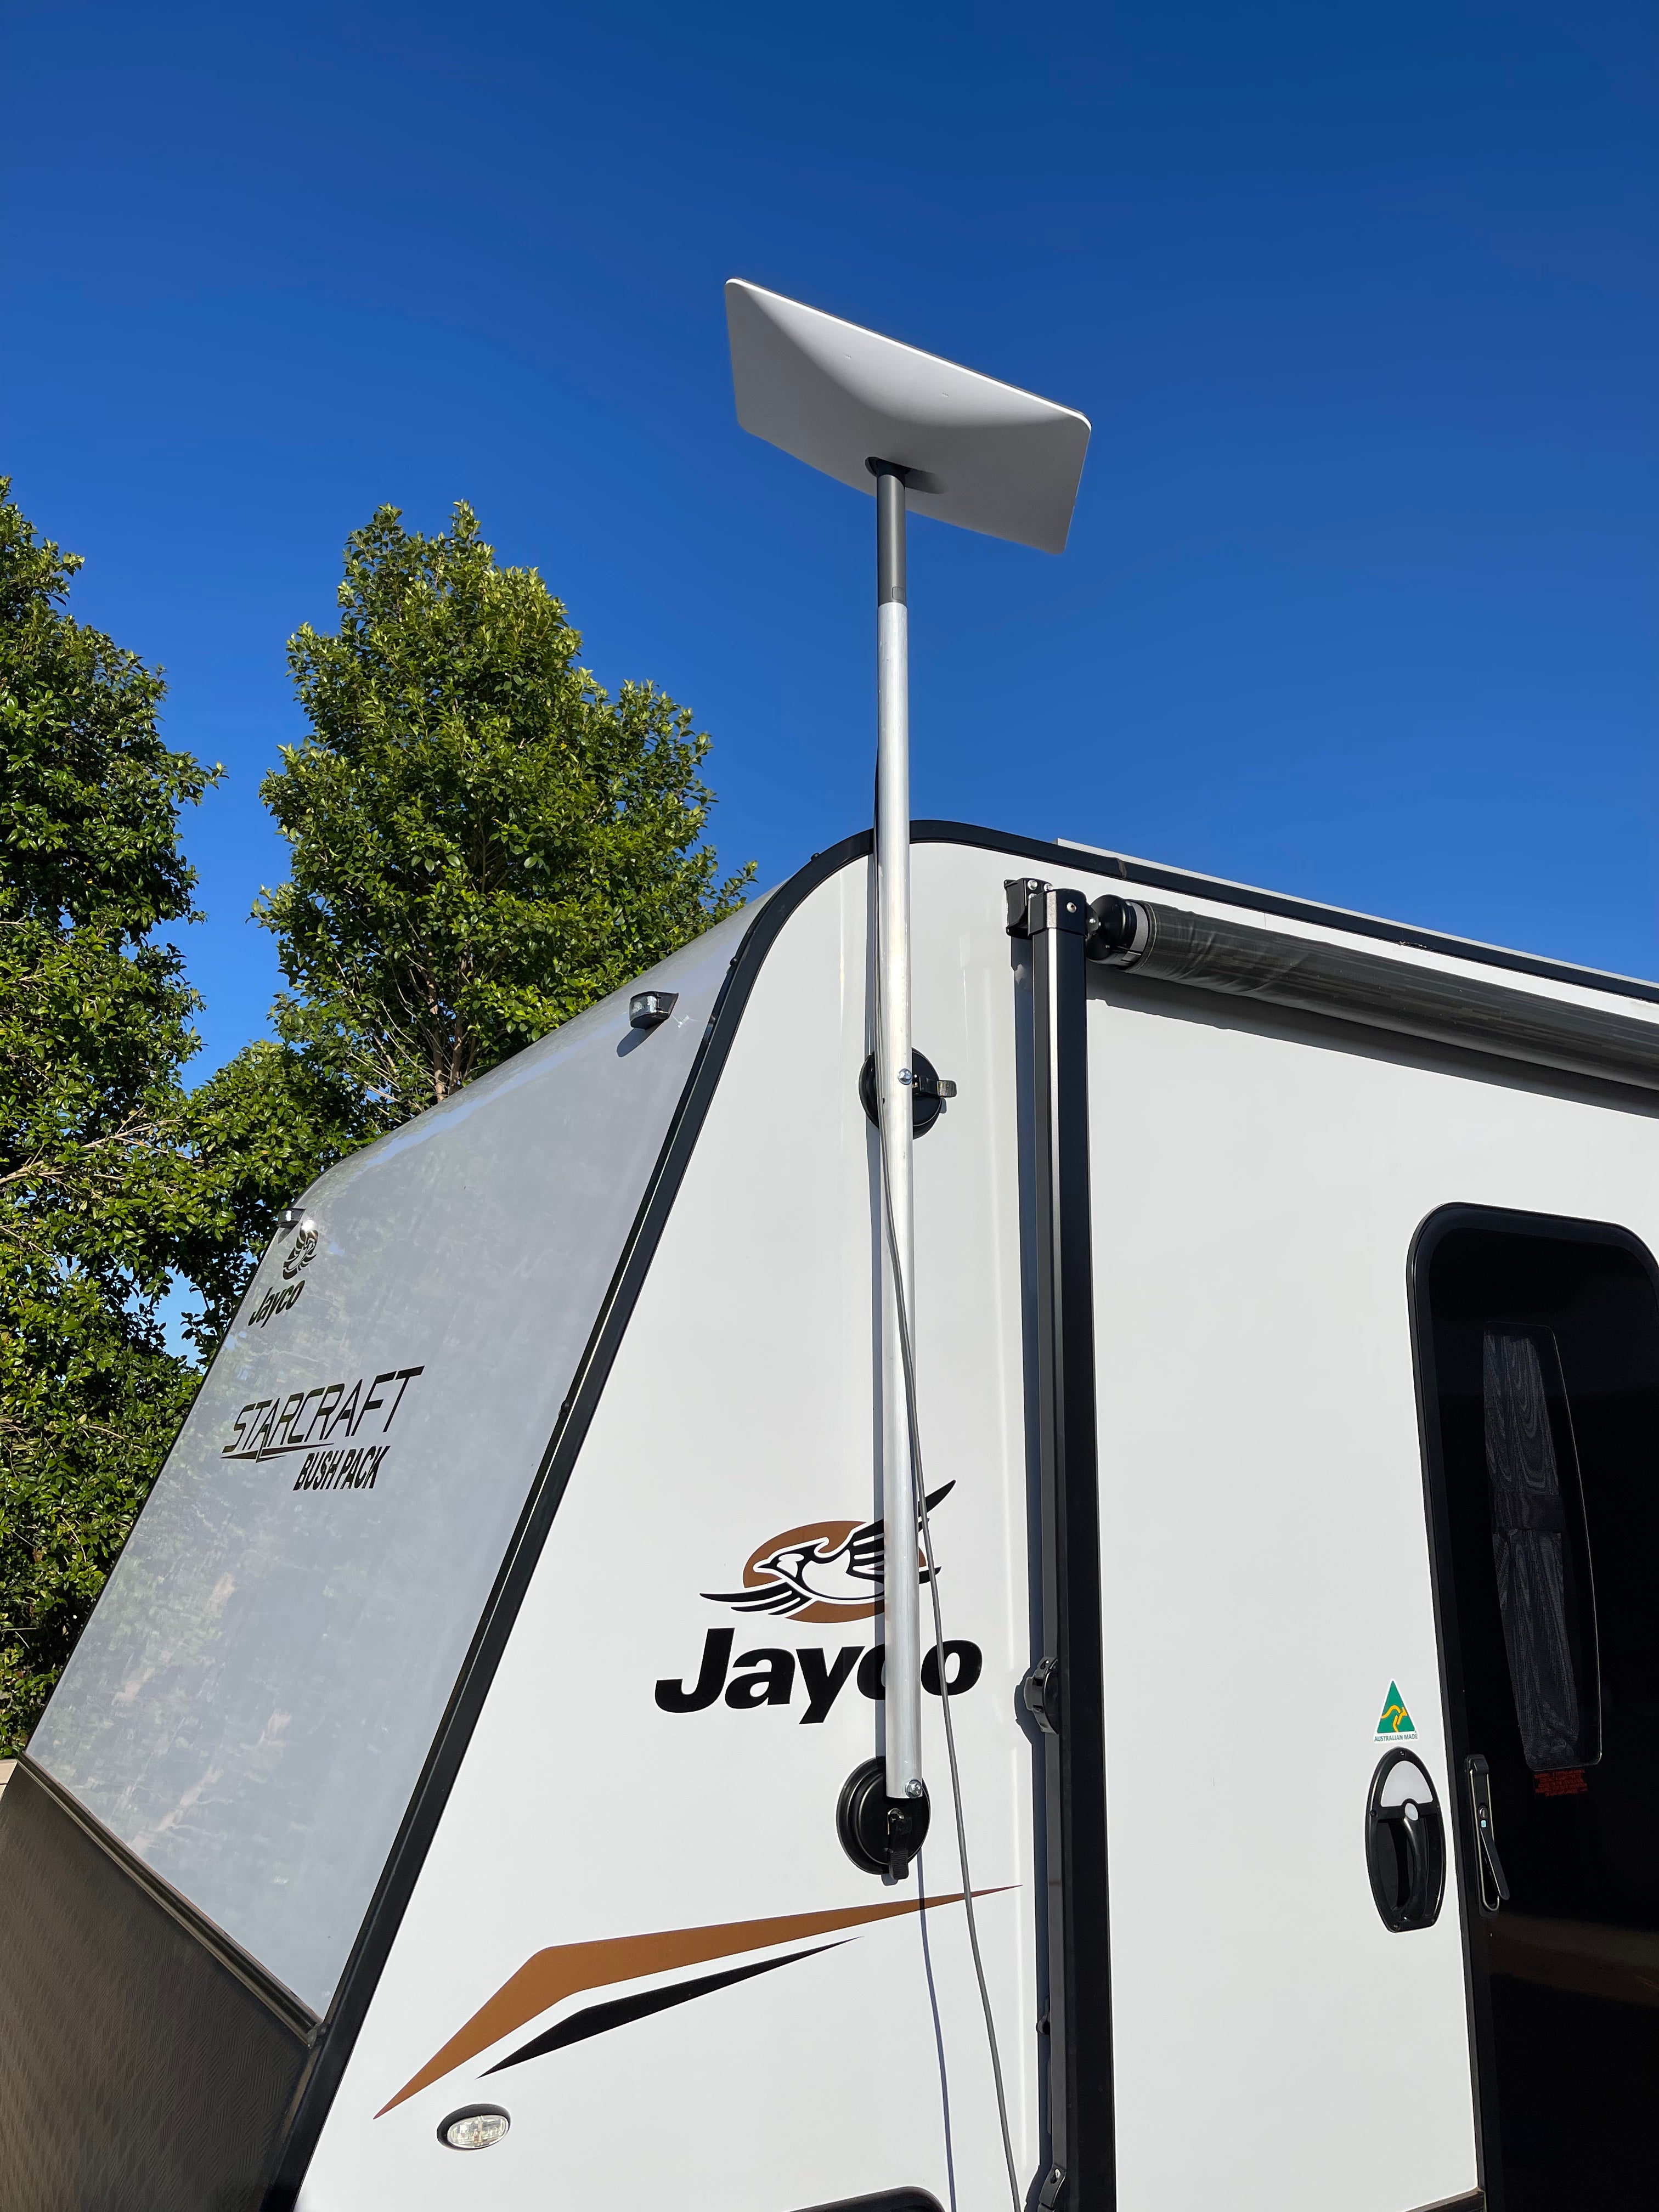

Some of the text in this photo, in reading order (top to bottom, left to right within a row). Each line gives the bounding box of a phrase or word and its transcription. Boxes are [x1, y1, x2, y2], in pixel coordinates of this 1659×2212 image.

[248, 1280, 306, 1329] Jayco
[222, 1365, 425, 1454] STARCRAFT
[292, 1445, 391, 1491] BUSH PACK
